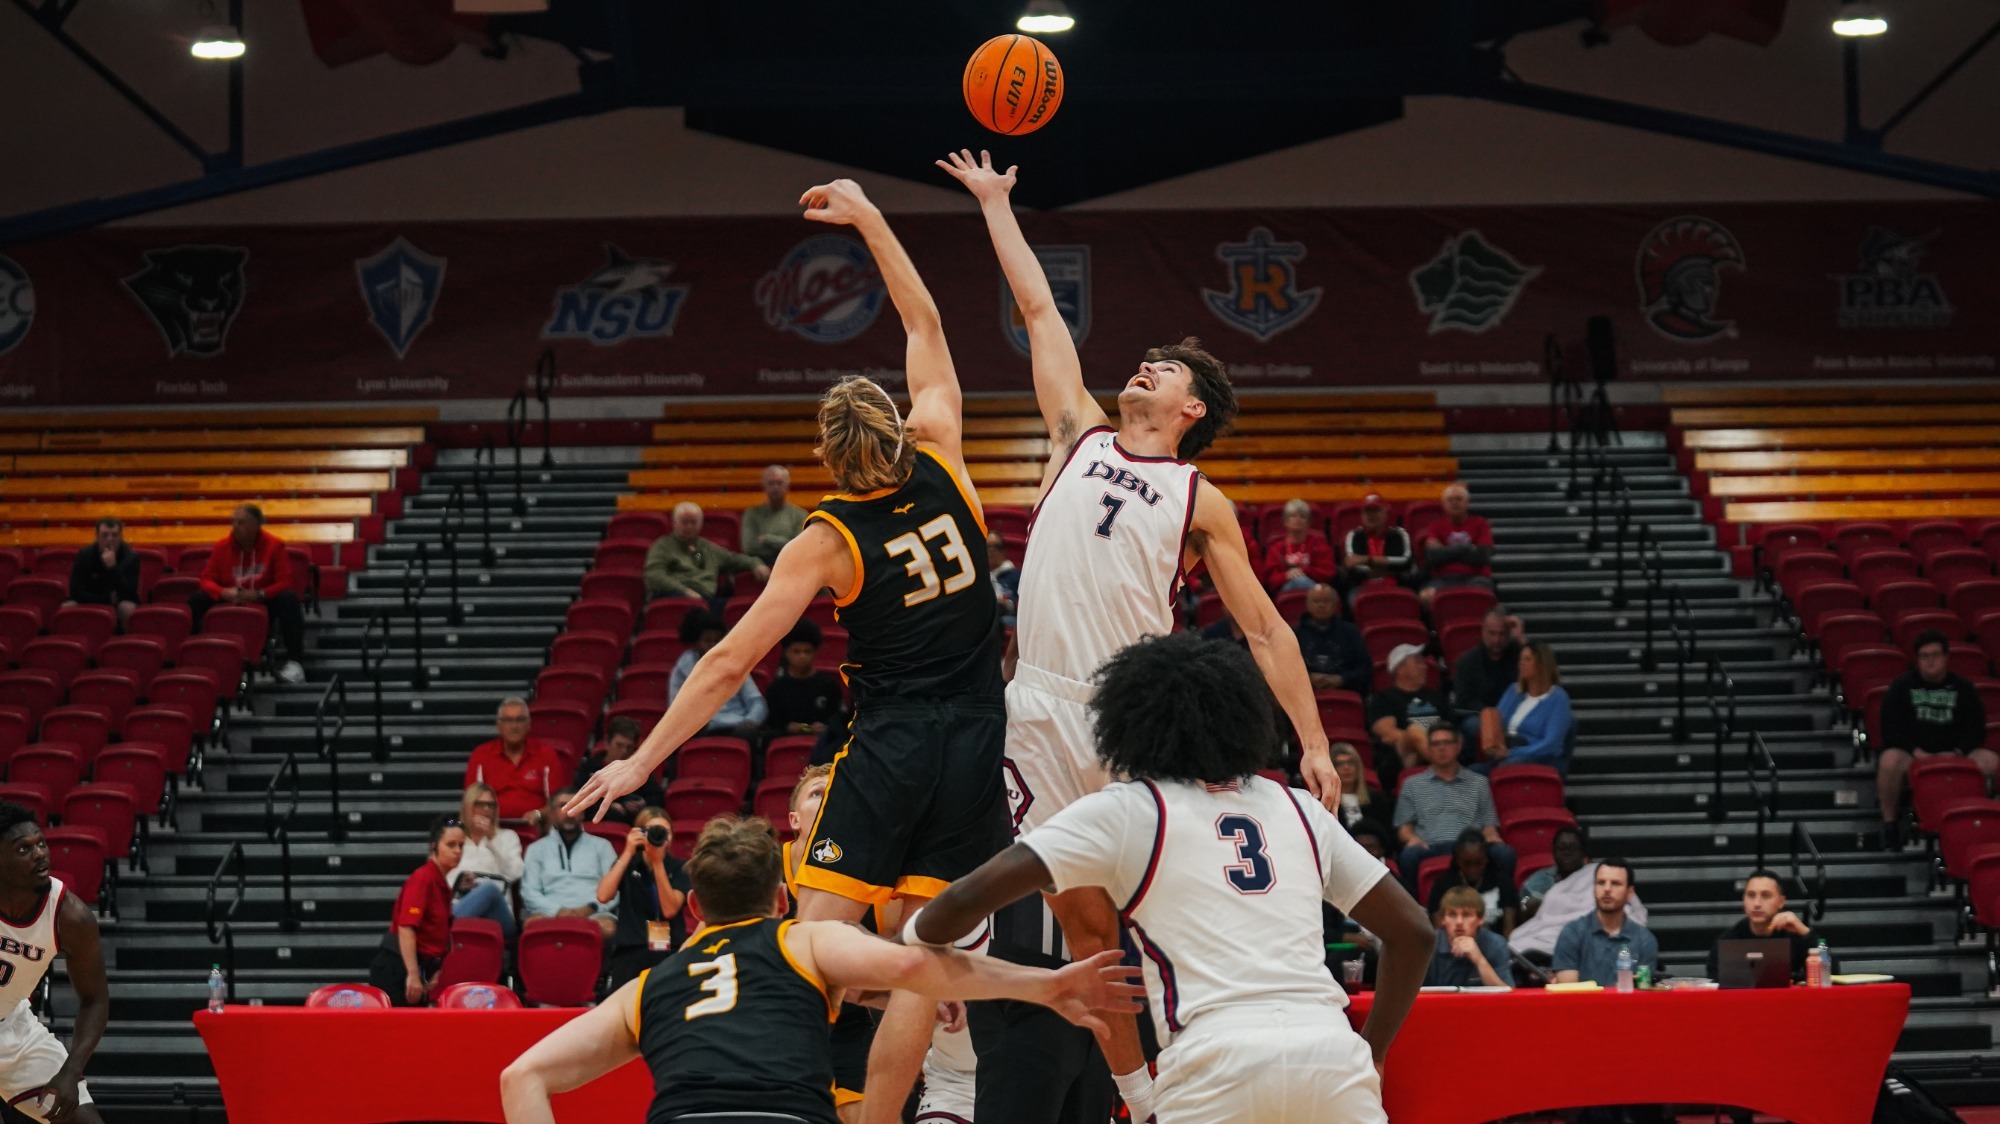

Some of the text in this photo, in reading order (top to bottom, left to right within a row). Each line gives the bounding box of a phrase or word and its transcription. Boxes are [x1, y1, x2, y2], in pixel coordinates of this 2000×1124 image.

[1006, 65, 1026, 108] EVO
[1028, 60, 1058, 124] Wilson
[1236, 261, 1291, 313] R
[1845, 277, 1942, 307] PBA
[548, 288, 683, 340] NSU
[155, 380, 198, 394] Florida
[357, 376, 450, 394] Lynn University
[644, 373, 705, 388] University
[1082, 459, 1163, 506] DBU
[1095, 491, 1126, 540] 7
[883, 513, 976, 607] 33
[1214, 812, 1276, 895] 3
[0, 935, 46, 962] BU
[686, 952, 738, 1021] 3
